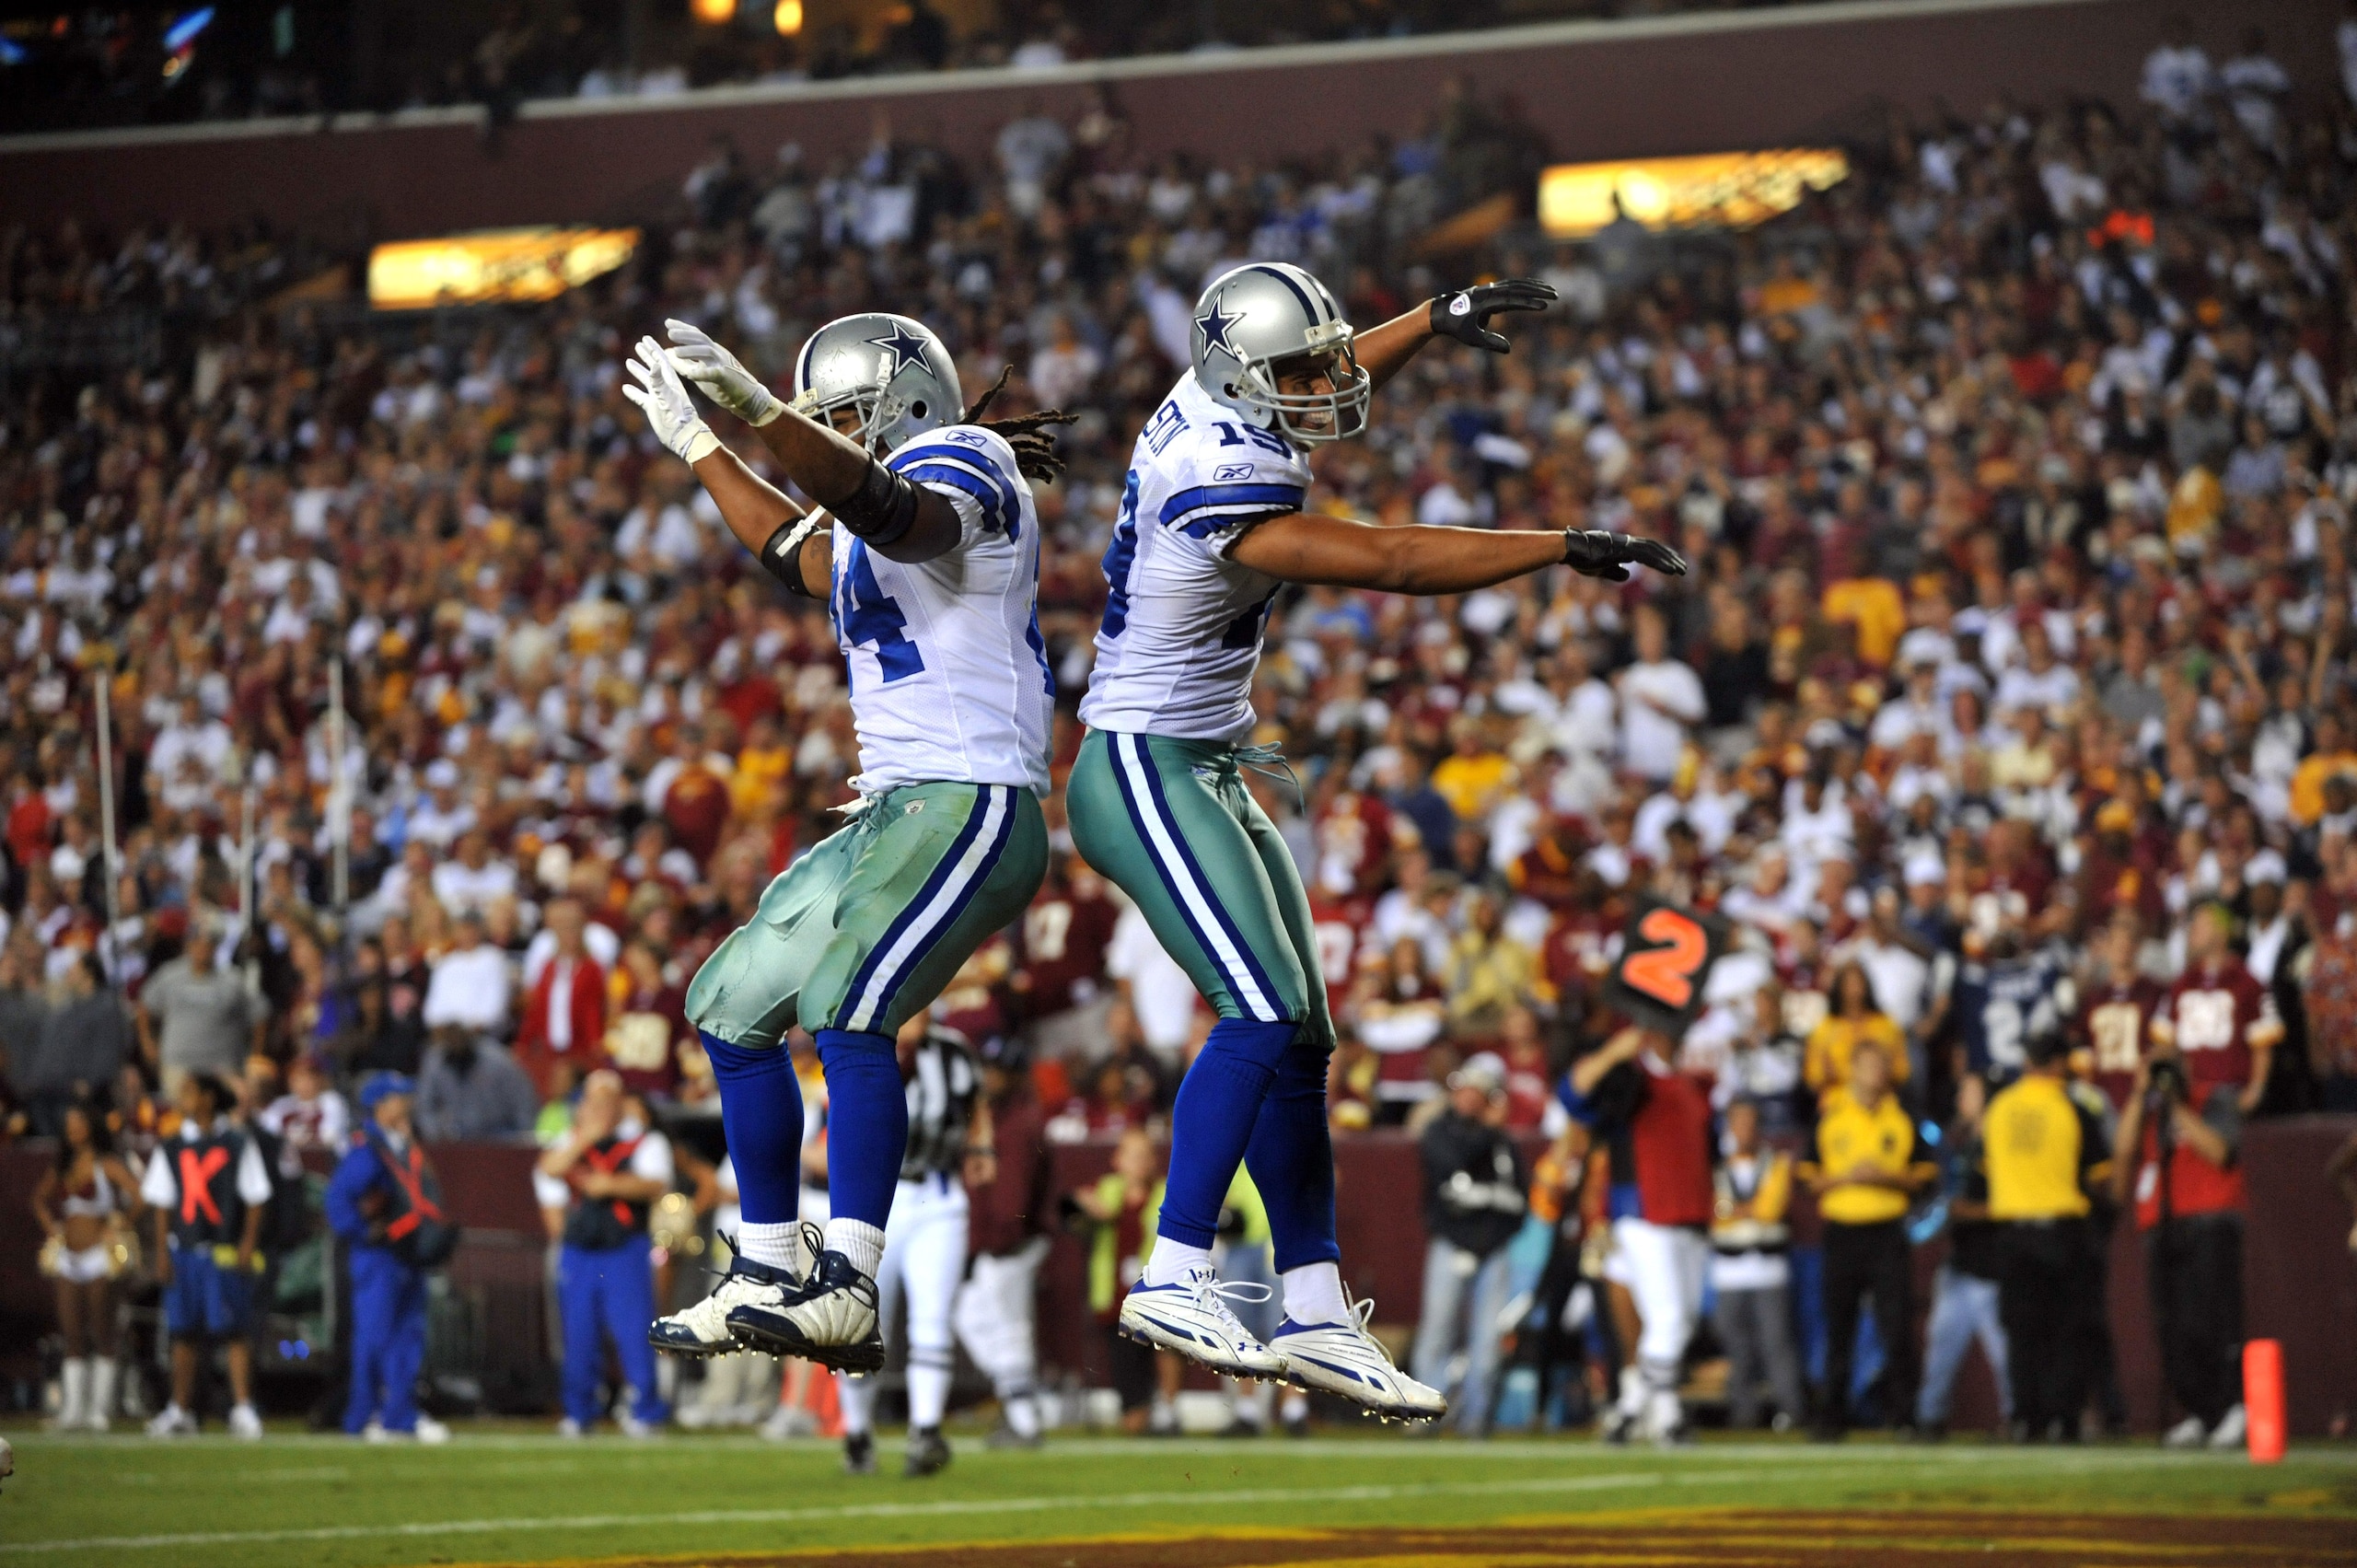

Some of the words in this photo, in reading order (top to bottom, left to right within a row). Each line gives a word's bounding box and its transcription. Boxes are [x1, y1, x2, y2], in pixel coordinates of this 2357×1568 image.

[1211, 421, 1293, 459] 19
[829, 537, 925, 699] 4
[1622, 907, 1708, 1009] 2
[179, 1146, 230, 1225] K
